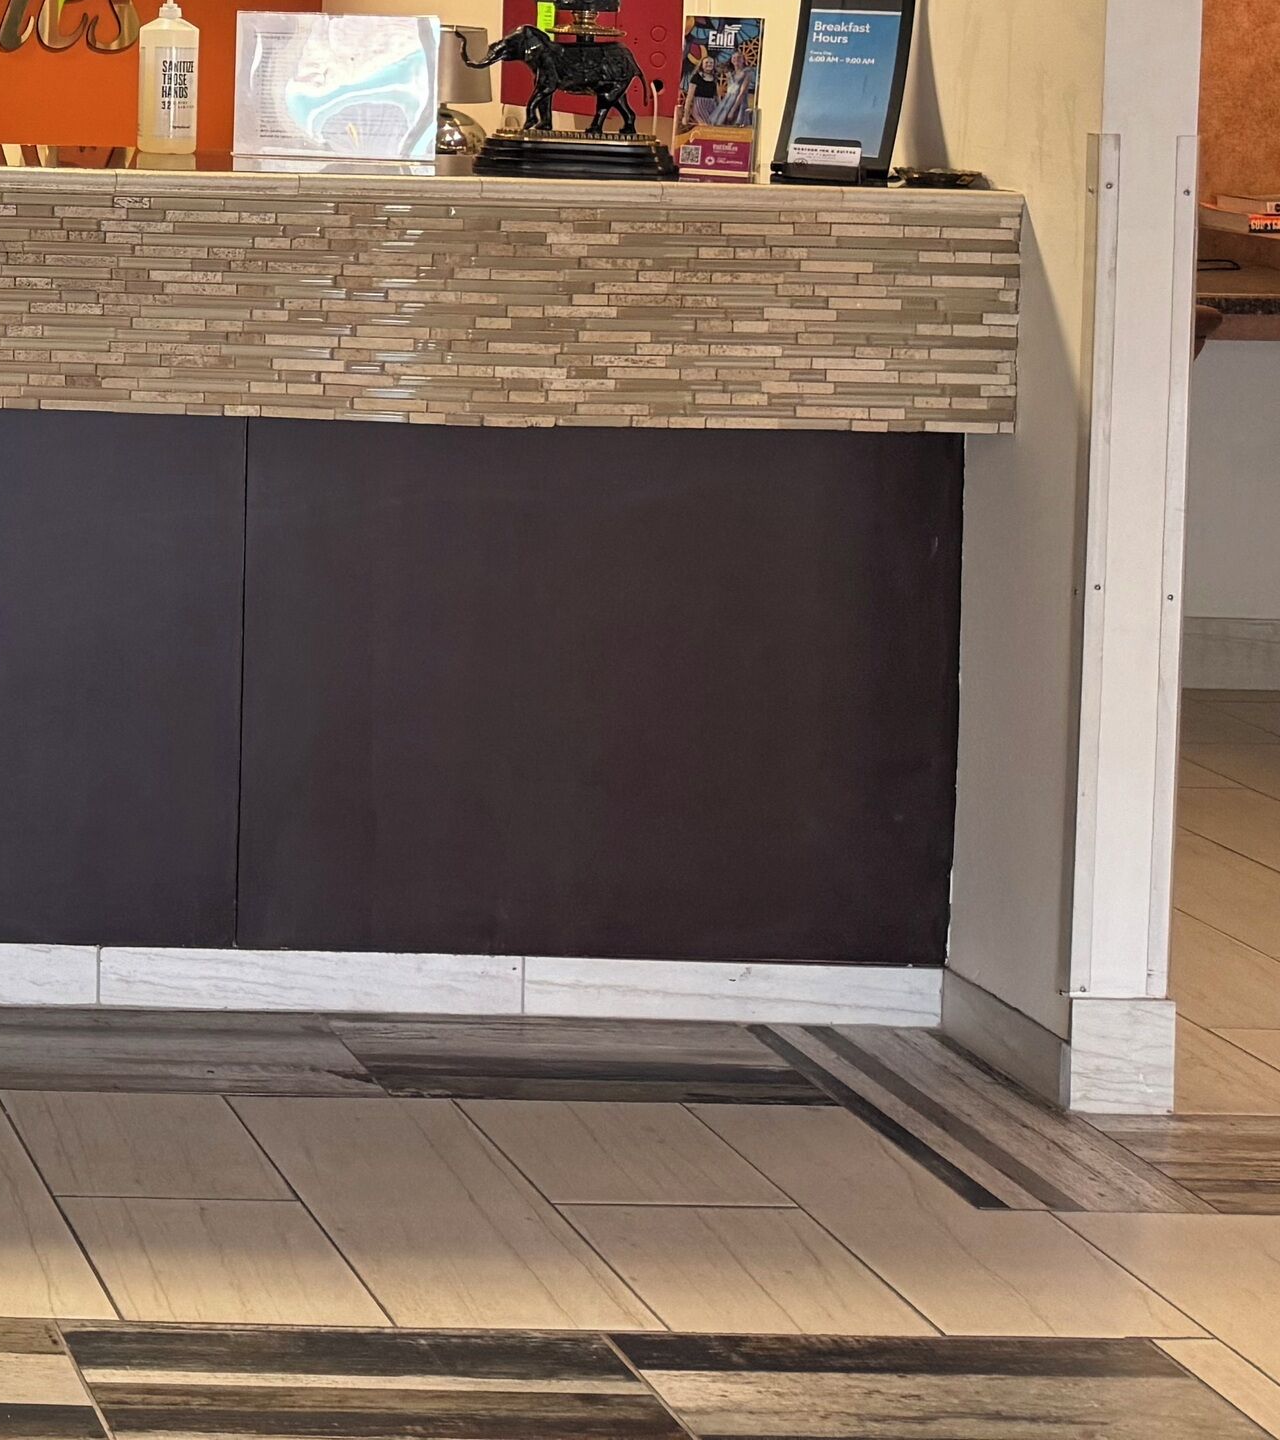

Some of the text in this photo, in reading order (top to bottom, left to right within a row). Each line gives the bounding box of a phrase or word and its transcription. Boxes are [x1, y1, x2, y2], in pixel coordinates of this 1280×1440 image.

[814, 21, 870, 33] Breakfast
[708, 26, 739, 48] Enid
[812, 32, 848, 43] Hours
[162, 60, 194, 73] SANITIZE
[162, 73, 187, 86] THOSE
[161, 86, 188, 98] HANDS
